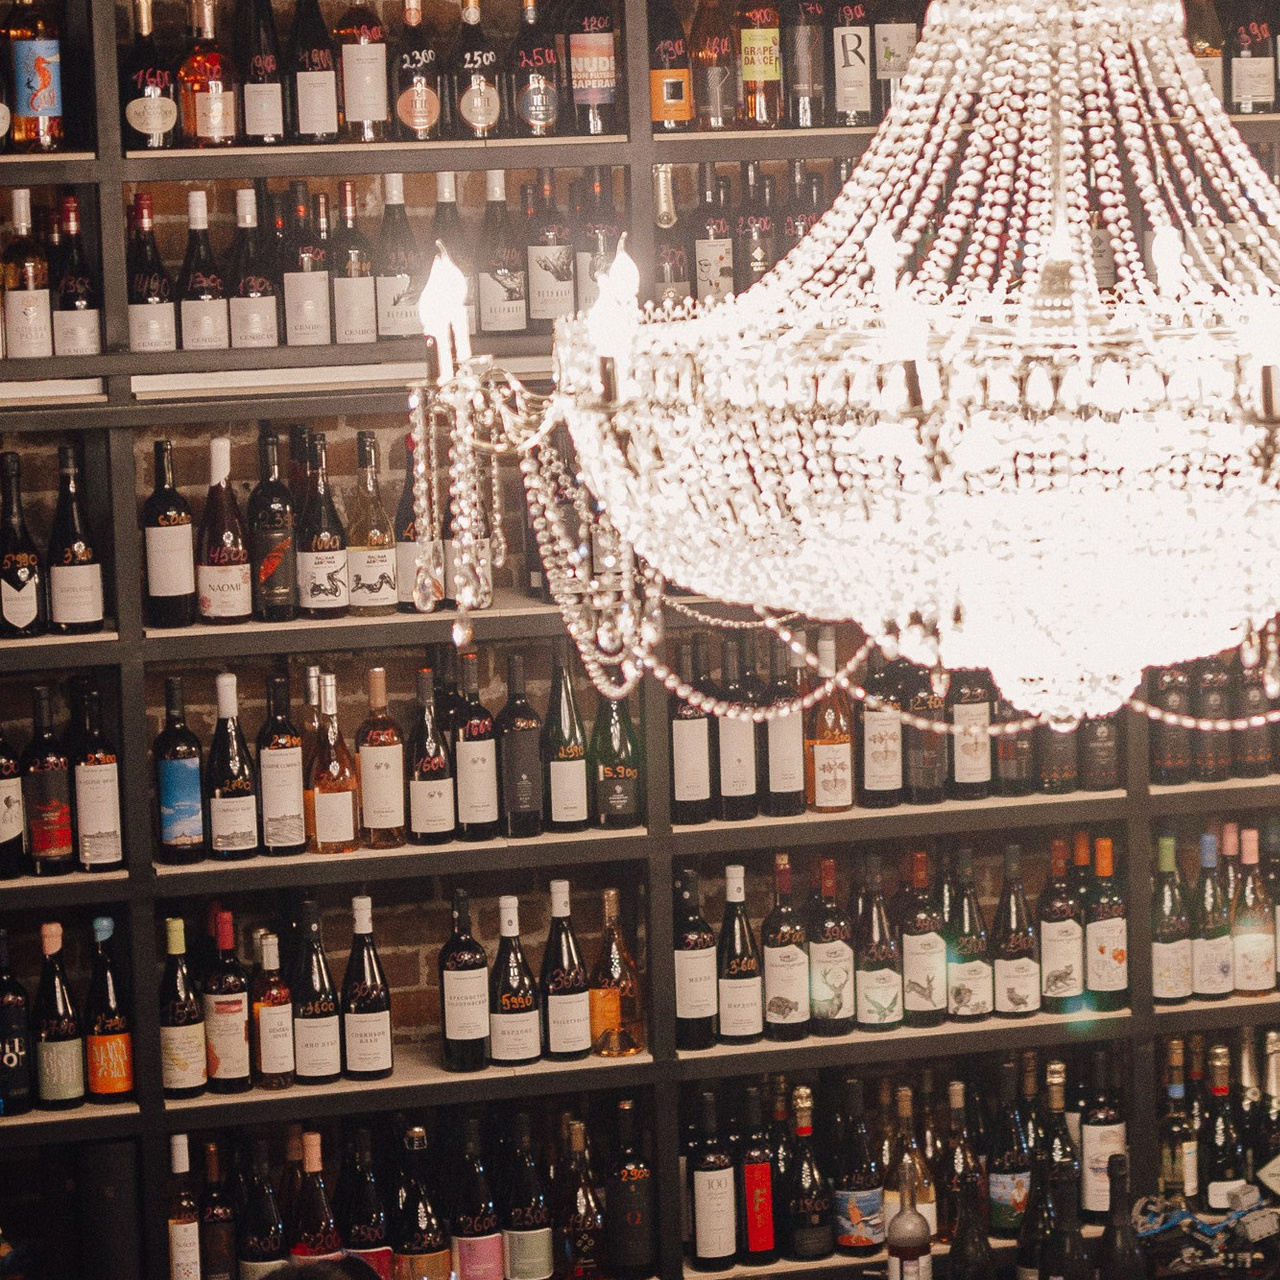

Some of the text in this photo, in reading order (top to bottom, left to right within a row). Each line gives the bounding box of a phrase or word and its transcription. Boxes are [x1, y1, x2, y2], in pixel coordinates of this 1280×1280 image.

[743, 45, 773, 56] GRAPE
[840, 32, 866, 68] R
[208, 583, 241, 593] NAOMI
